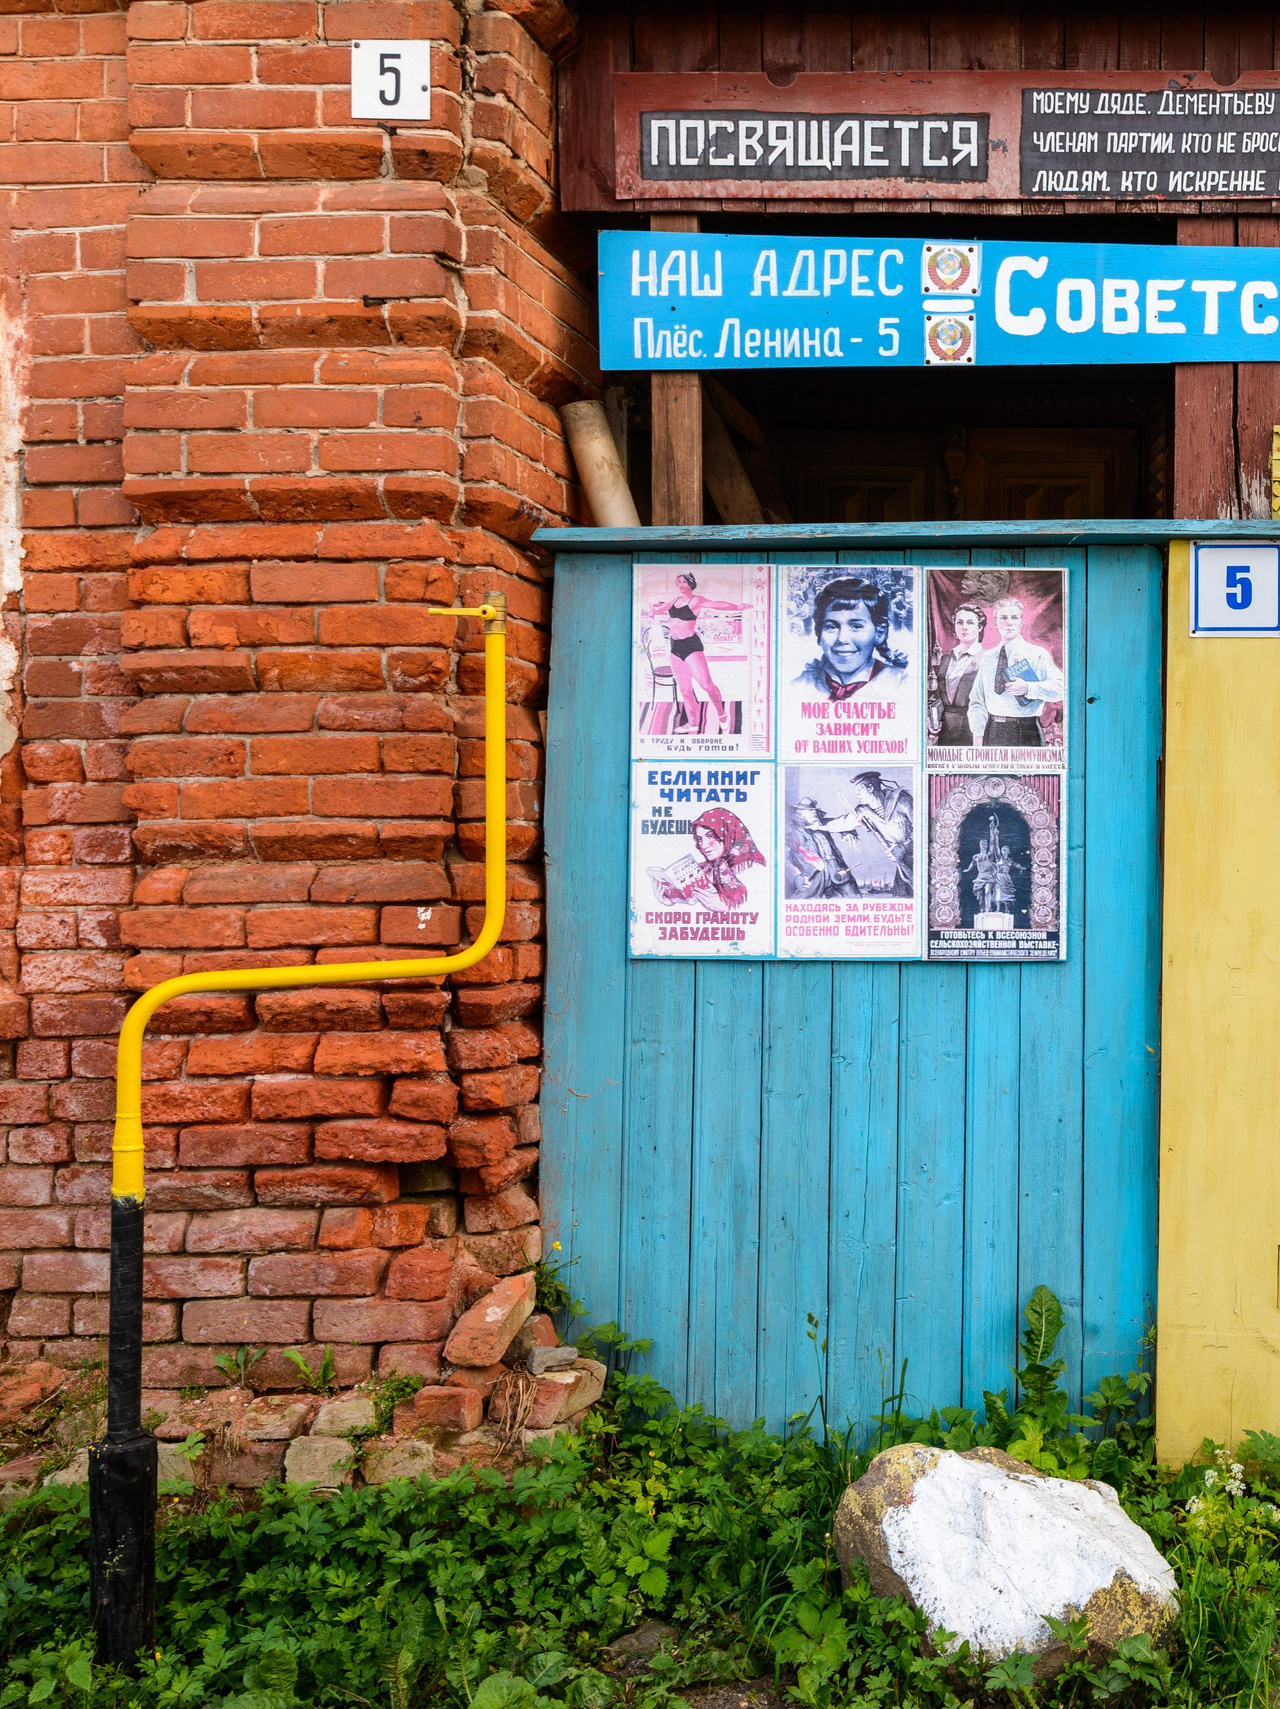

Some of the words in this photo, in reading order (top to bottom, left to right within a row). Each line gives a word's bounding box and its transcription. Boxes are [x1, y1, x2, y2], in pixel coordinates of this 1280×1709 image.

[379, 53, 401, 106] 5
[1032, 91, 1090, 114] МОЕМУ
[1157, 90, 1275, 115] ДЕМЕНТЬЕВУ
[650, 119, 979, 171] ПОСВЯЩАЕТСЯ
[1033, 131, 1098, 153] ЧЛЕНАМ
[1181, 132, 1211, 153] КТО
[1217, 132, 1236, 153] НЕ
[1121, 171, 1158, 192] КТО
[1168, 170, 1266, 192] ИСКРЕННЕ
[631, 249, 723, 297] НАШ
[751, 248, 904, 297] АДРЕС
[714, 317, 844, 358] Ленина
[878, 317, 900, 356] 5
[1226, 565, 1253, 610] 5
[801, 702, 830, 719] МОЕ
[834, 702, 896, 719] СЧАСТЬЕ
[815, 723, 880, 736] ЗАВИСИТ
[794, 740, 809, 753] ОТ
[812, 740, 852, 753] ВАШИХ
[857, 738, 908, 754] УСПЕХОВ!
[927, 748, 963, 762] МОЛОДЫЕ
[966, 748, 1009, 762] СТРОИТЕЛИ
[647, 770, 701, 785] ЕСЛИ
[707, 770, 760, 785] КНИГ
[660, 788, 748, 802] ЧИТАТЬ
[652, 806, 673, 817] НЕ
[785, 903, 841, 913] НАХОДЯСЬ
[846, 903, 859, 912] ЗА
[862, 903, 914, 912] РУБЕЖОМ
[645, 911, 691, 924] СКОРО
[696, 911, 759, 924] ГРАМОТУ
[785, 913, 830, 923] РОДНОЙ
[873, 913, 913, 923] БУДЬТЕ
[658, 927, 746, 941] ЗАБУДЕШЬ
[785, 925, 839, 936] ОСОБЕННО
[845, 924, 914, 937] БДИТЕЛЬНЫ!
[940, 931, 985, 940] ГОТОВЬТЕСЬ
[988, 931, 994, 940] К
[996, 930, 1047, 940] ВСЕСОЮЗНОЙ
[930, 940, 1017, 949] СЕЛЬСКОХОЗЯЙСТВЕННОЙ
